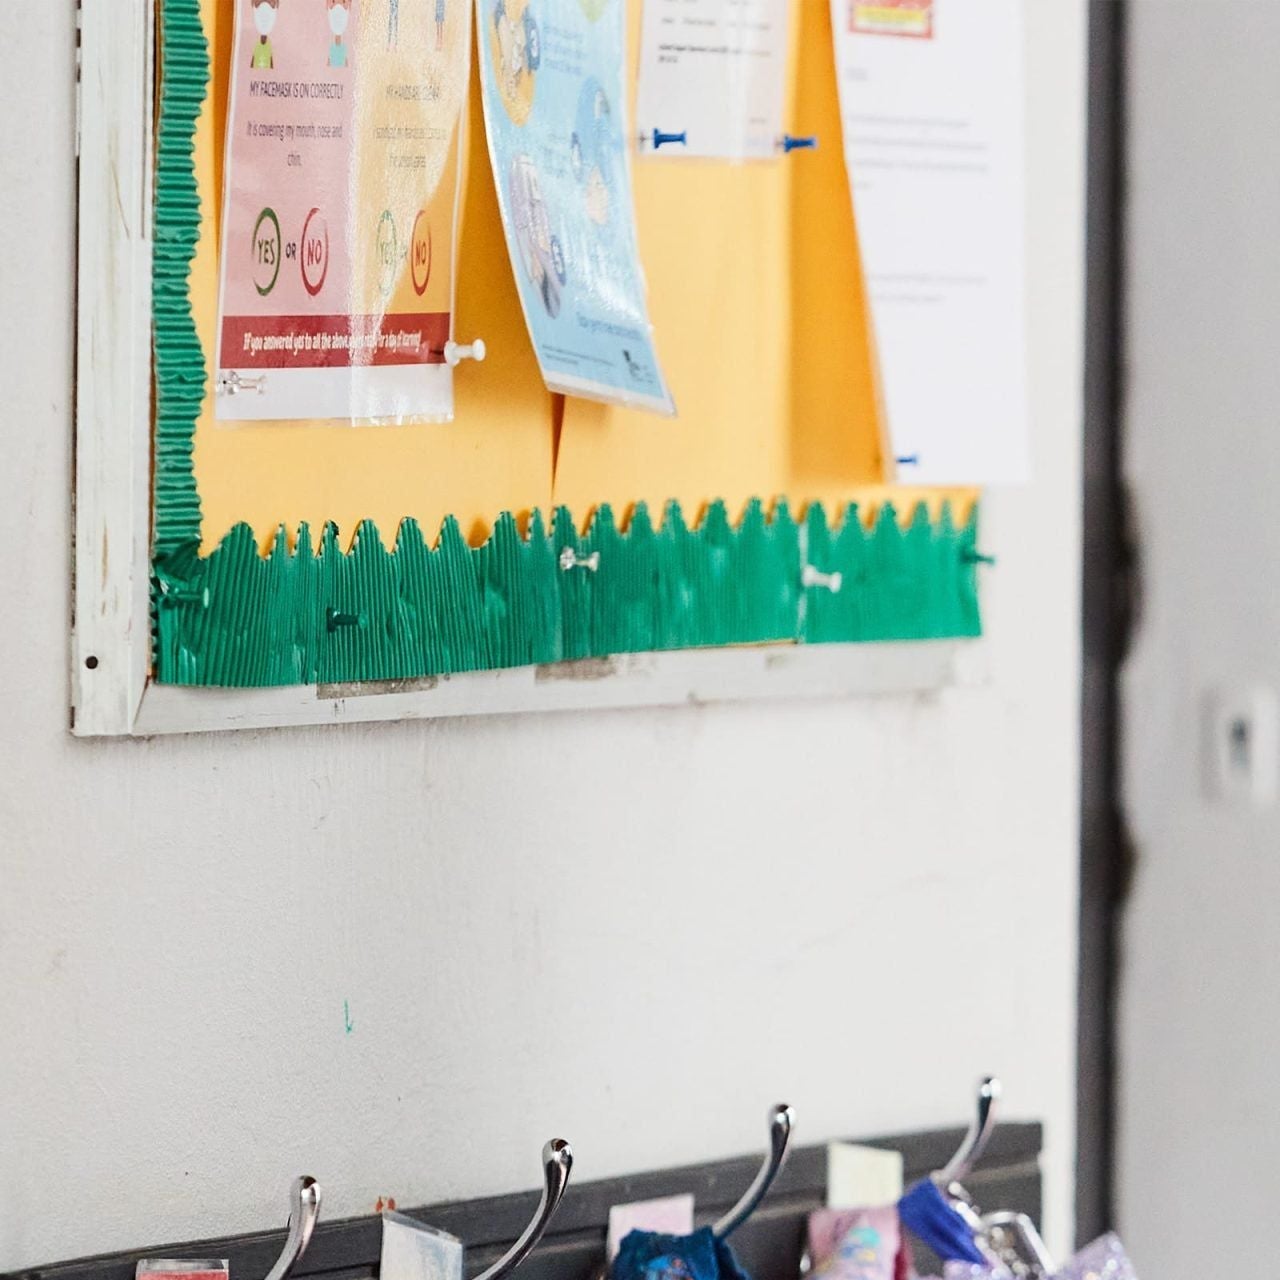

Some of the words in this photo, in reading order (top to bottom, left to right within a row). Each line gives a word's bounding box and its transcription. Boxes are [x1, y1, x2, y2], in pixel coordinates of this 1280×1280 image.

[250, 81, 260, 97] MY
[260, 81, 292, 98] FACEMASK
[300, 82, 309, 98] ON
[310, 83, 344, 99] CORRECTLY
[258, 123, 285, 141] covering
[257, 238, 275, 265] YES
[286, 242, 296, 260] OR
[308, 239, 322, 266] NO
[415, 240, 426, 266] NO
